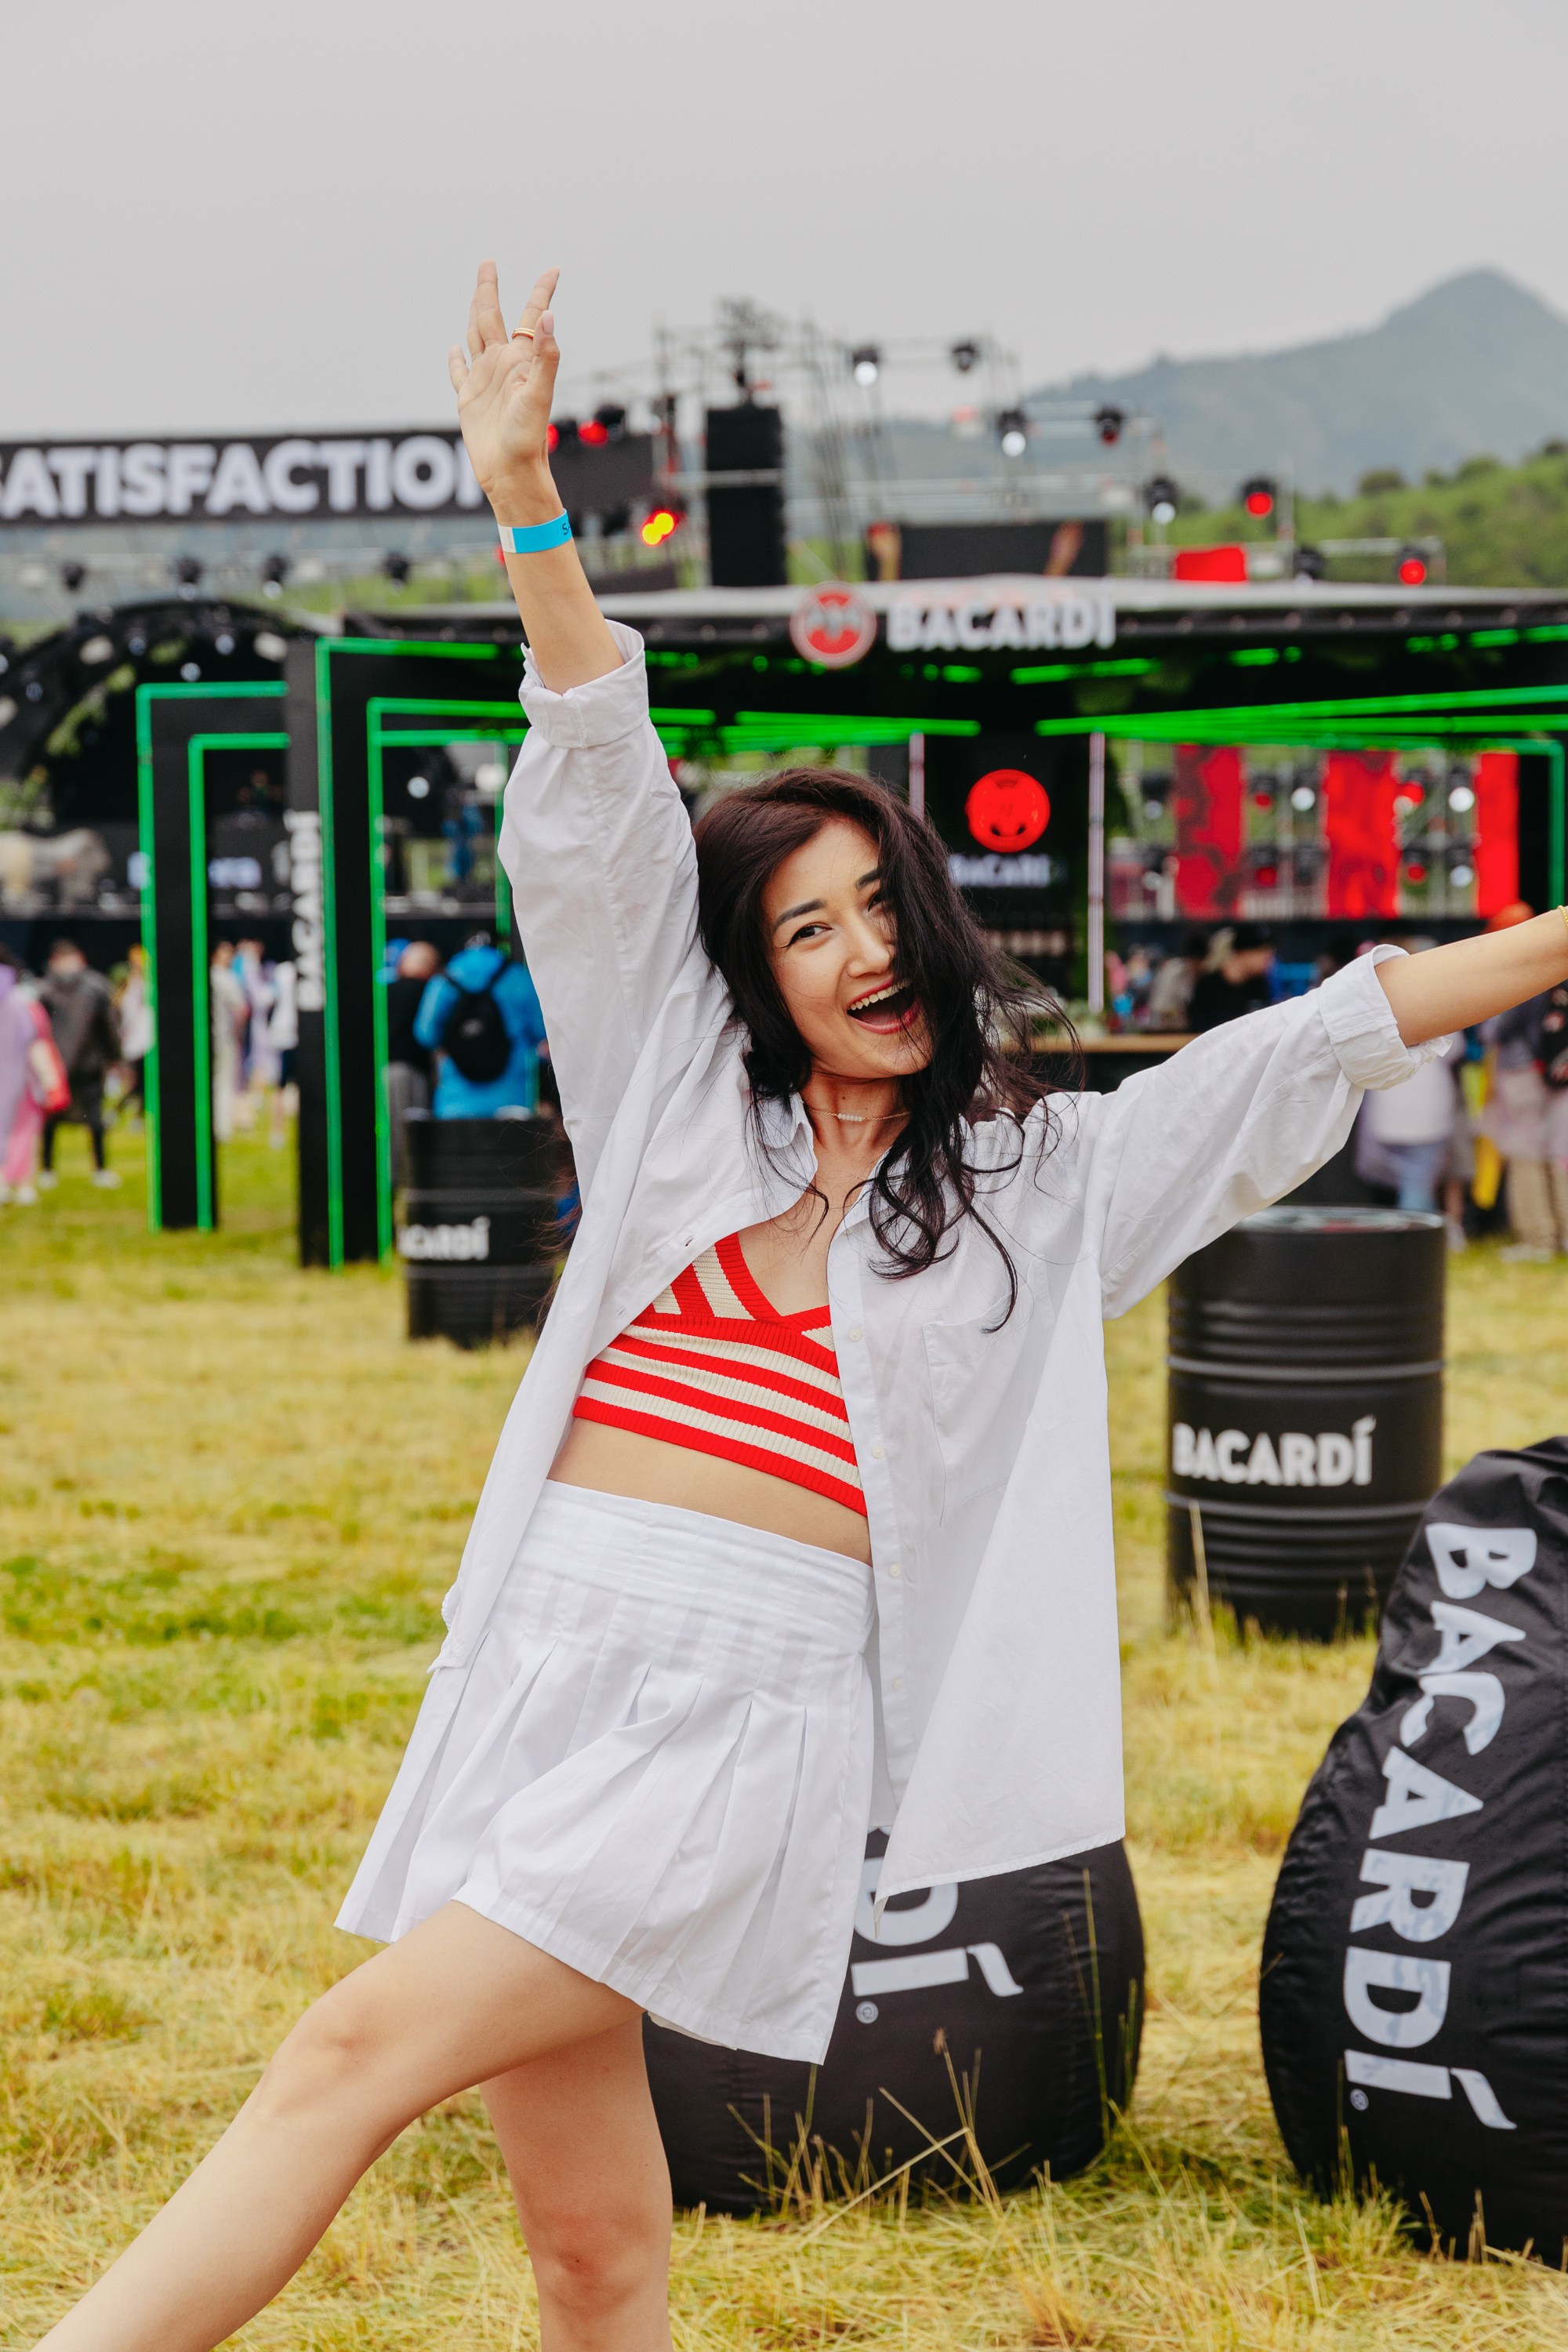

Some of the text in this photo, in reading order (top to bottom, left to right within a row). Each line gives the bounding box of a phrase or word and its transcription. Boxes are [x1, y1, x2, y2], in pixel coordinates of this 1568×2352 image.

[0, 434, 487, 521] ATISFACTIO
[1173, 1414, 1377, 1486] BACARDÍ
[1343, 1523, 1537, 2130] BACARDÍ
